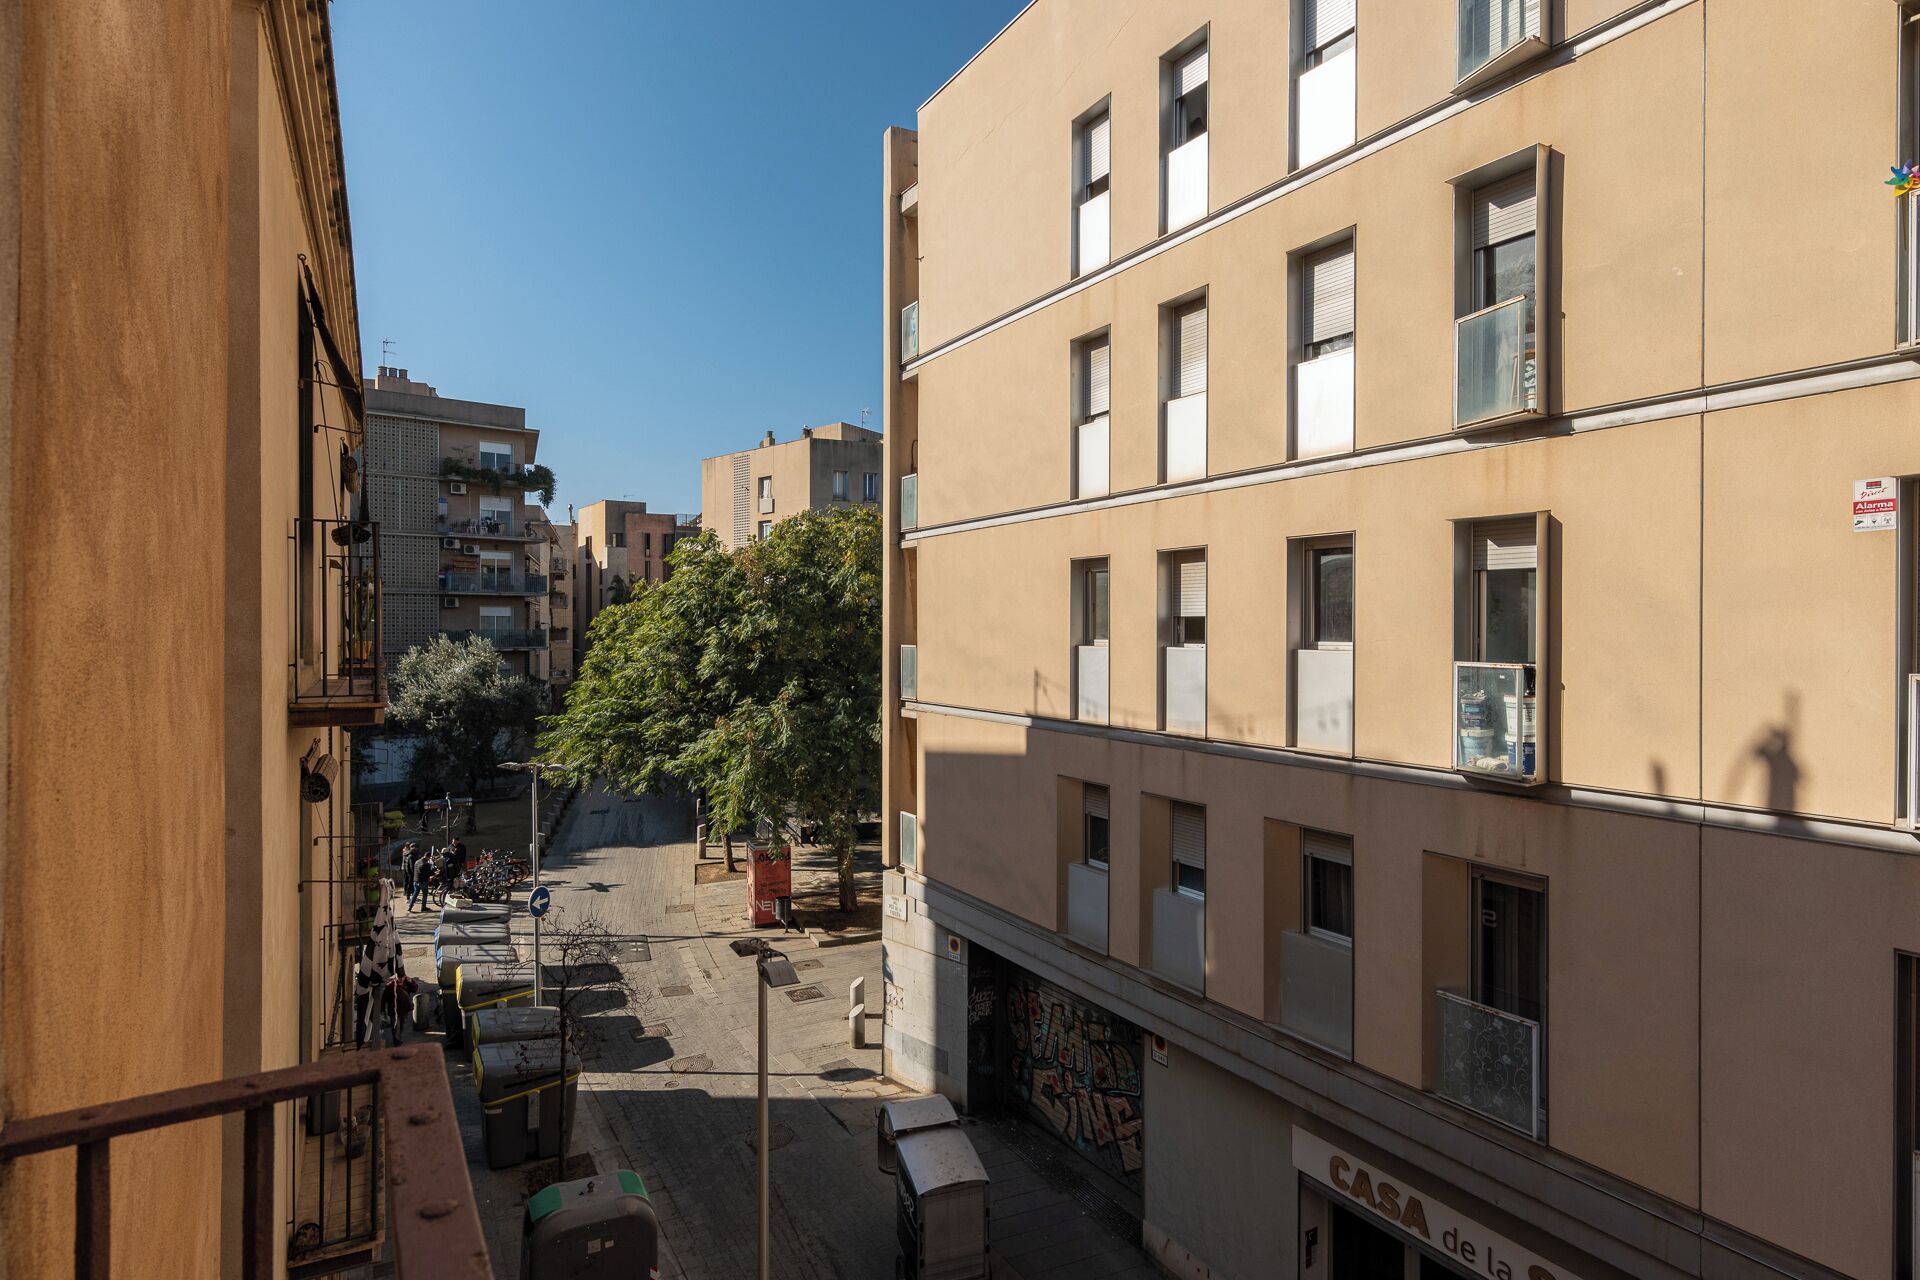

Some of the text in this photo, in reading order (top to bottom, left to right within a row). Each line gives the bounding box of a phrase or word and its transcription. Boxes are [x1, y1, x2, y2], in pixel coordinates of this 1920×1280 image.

[1855, 501, 1894, 510] Alarma
[1329, 1155, 1431, 1240] CASA
[1443, 1227, 1476, 1263] de
[1487, 1246, 1512, 1280] la
